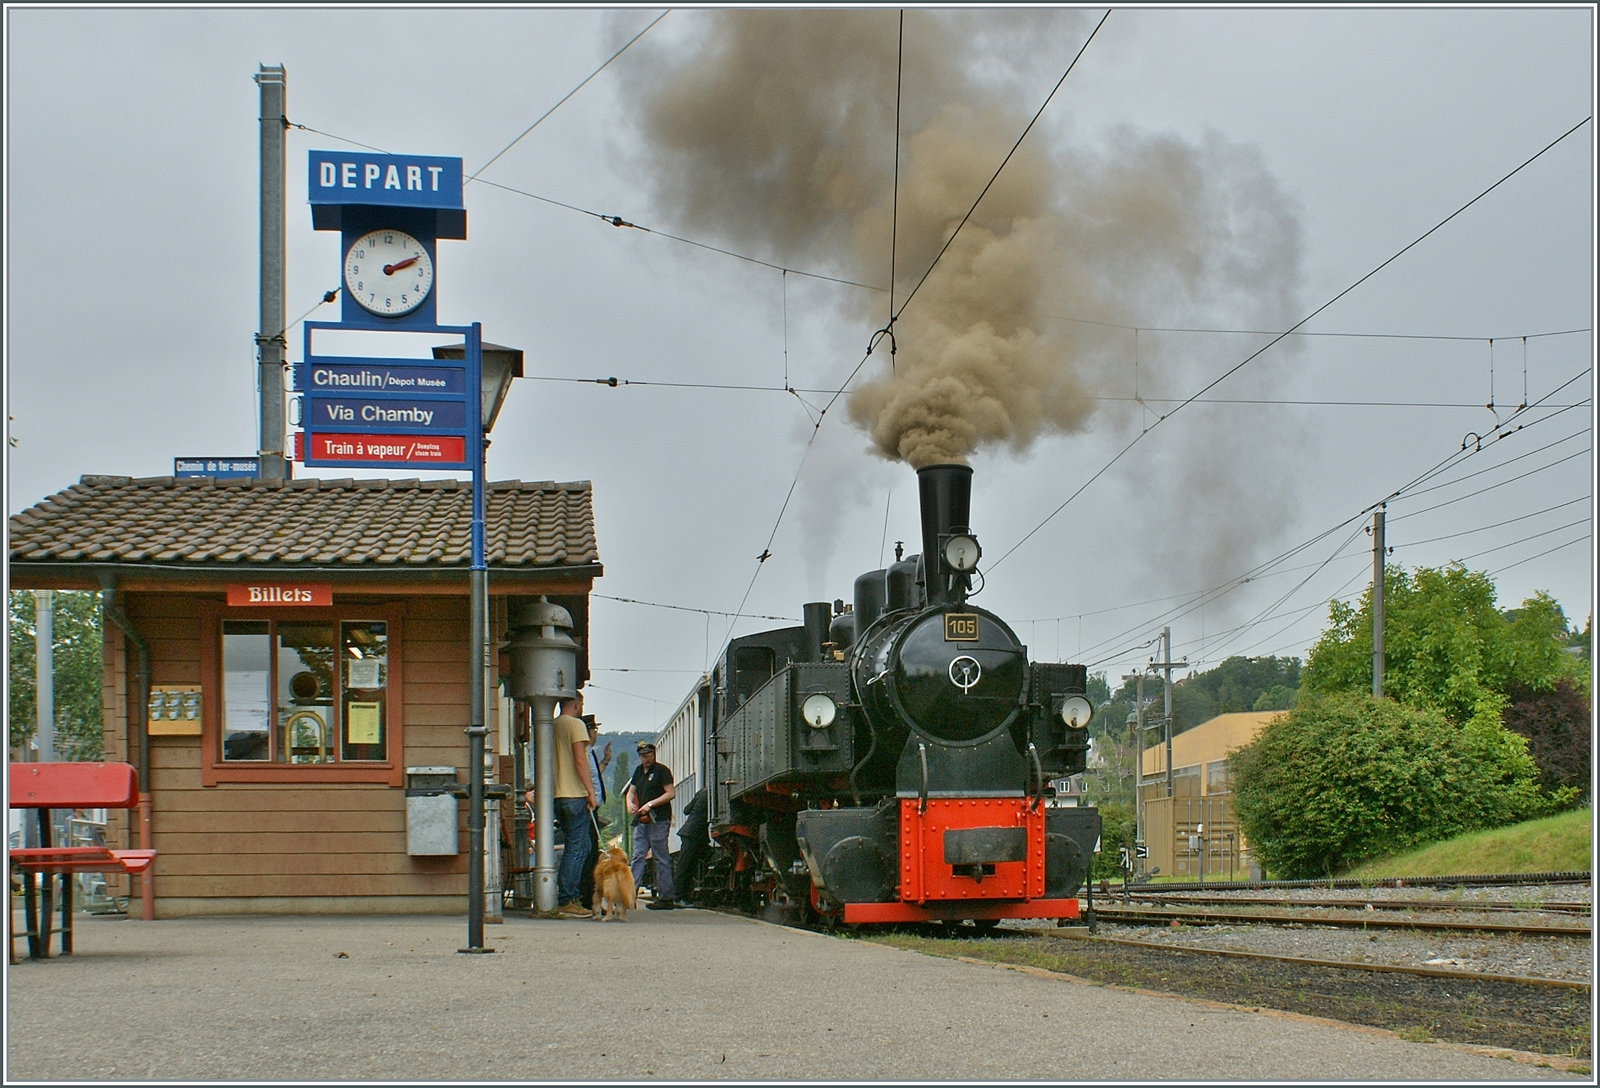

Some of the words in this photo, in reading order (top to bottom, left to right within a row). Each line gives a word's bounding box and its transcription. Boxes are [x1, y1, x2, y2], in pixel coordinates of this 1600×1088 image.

[319, 162, 443, 191] DEPART
[369, 239, 376, 248] 11
[384, 235, 393, 244] 12
[355, 250, 365, 259] 10
[353, 265, 359, 275] 9
[418, 268, 424, 277] 3
[358, 281, 363, 291] 8
[414, 284, 420, 293] 4
[369, 293, 375, 303] 7
[385, 298, 391, 308] 6
[402, 295, 408, 304] 5
[326, 404, 355, 421] Via
[361, 405, 434, 426] Chamby
[324, 440, 354, 455] Train
[356, 442, 364, 455] à
[176, 460, 204, 472] Chemin
[207, 460, 217, 472] de
[218, 460, 257, 472] fer-musée
[247, 586, 312, 602] Billets
[949, 620, 975, 634] 105
